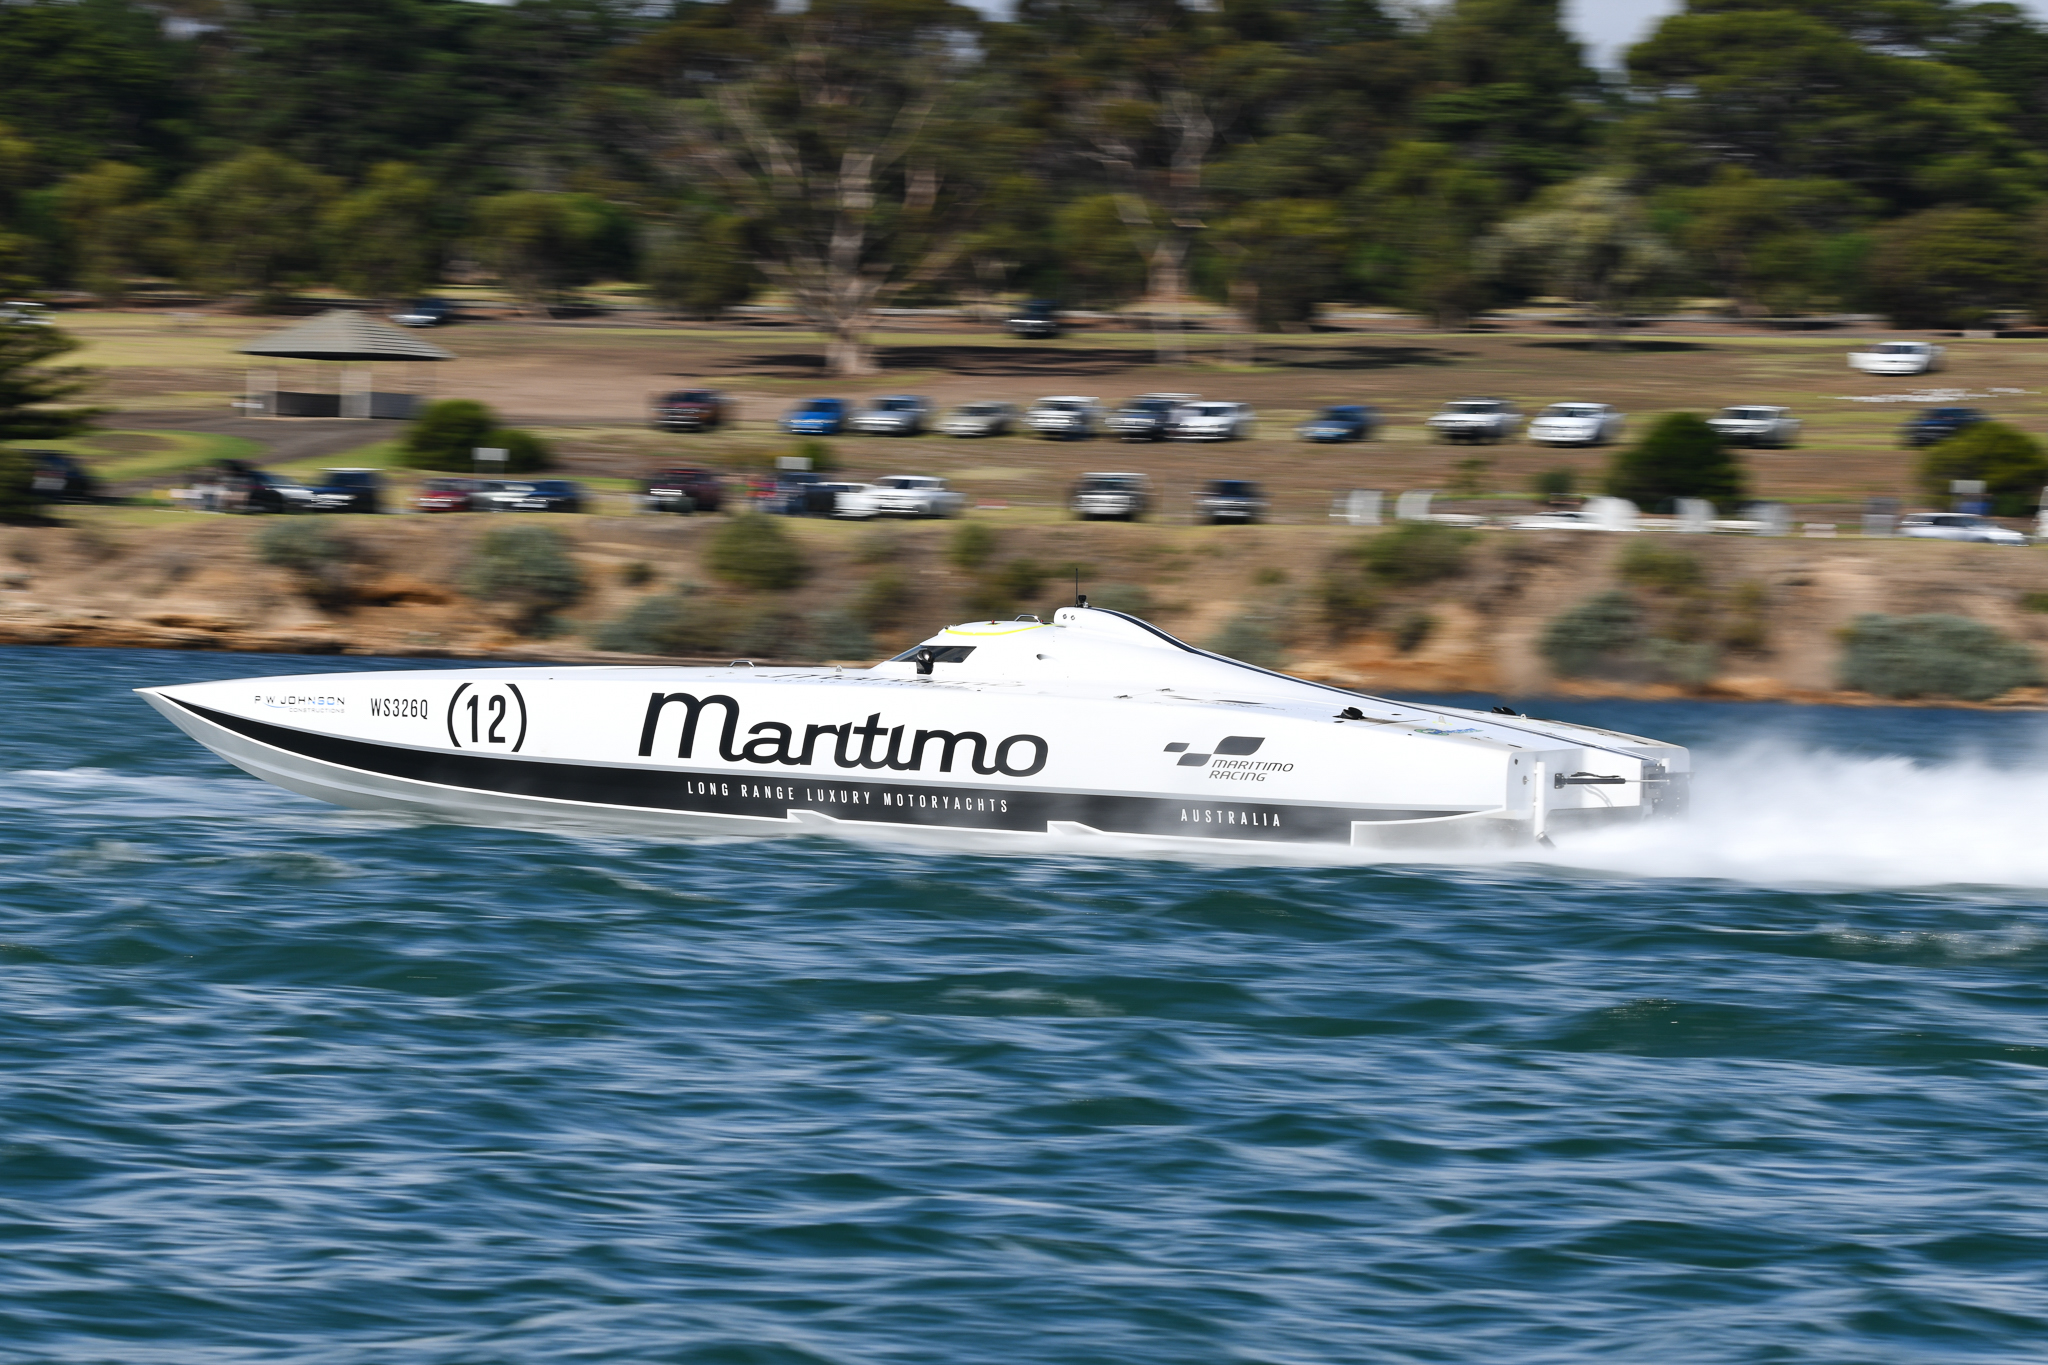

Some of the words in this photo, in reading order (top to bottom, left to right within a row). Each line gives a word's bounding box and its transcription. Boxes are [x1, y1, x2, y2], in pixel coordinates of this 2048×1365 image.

[265, 695, 276, 704] W
[280, 696, 345, 706] JOHNSON
[370, 697, 428, 720] WS326Q
[1211, 759, 1294, 772] MARITIMO
[1208, 770, 1268, 782] RACING
[687, 780, 730, 797] LONG
[740, 784, 795, 801] RANGE
[806, 788, 871, 806] LUXURY
[883, 792, 1008, 814] MOTORYACHTS
[1180, 808, 1281, 828] AUSTRALIA
